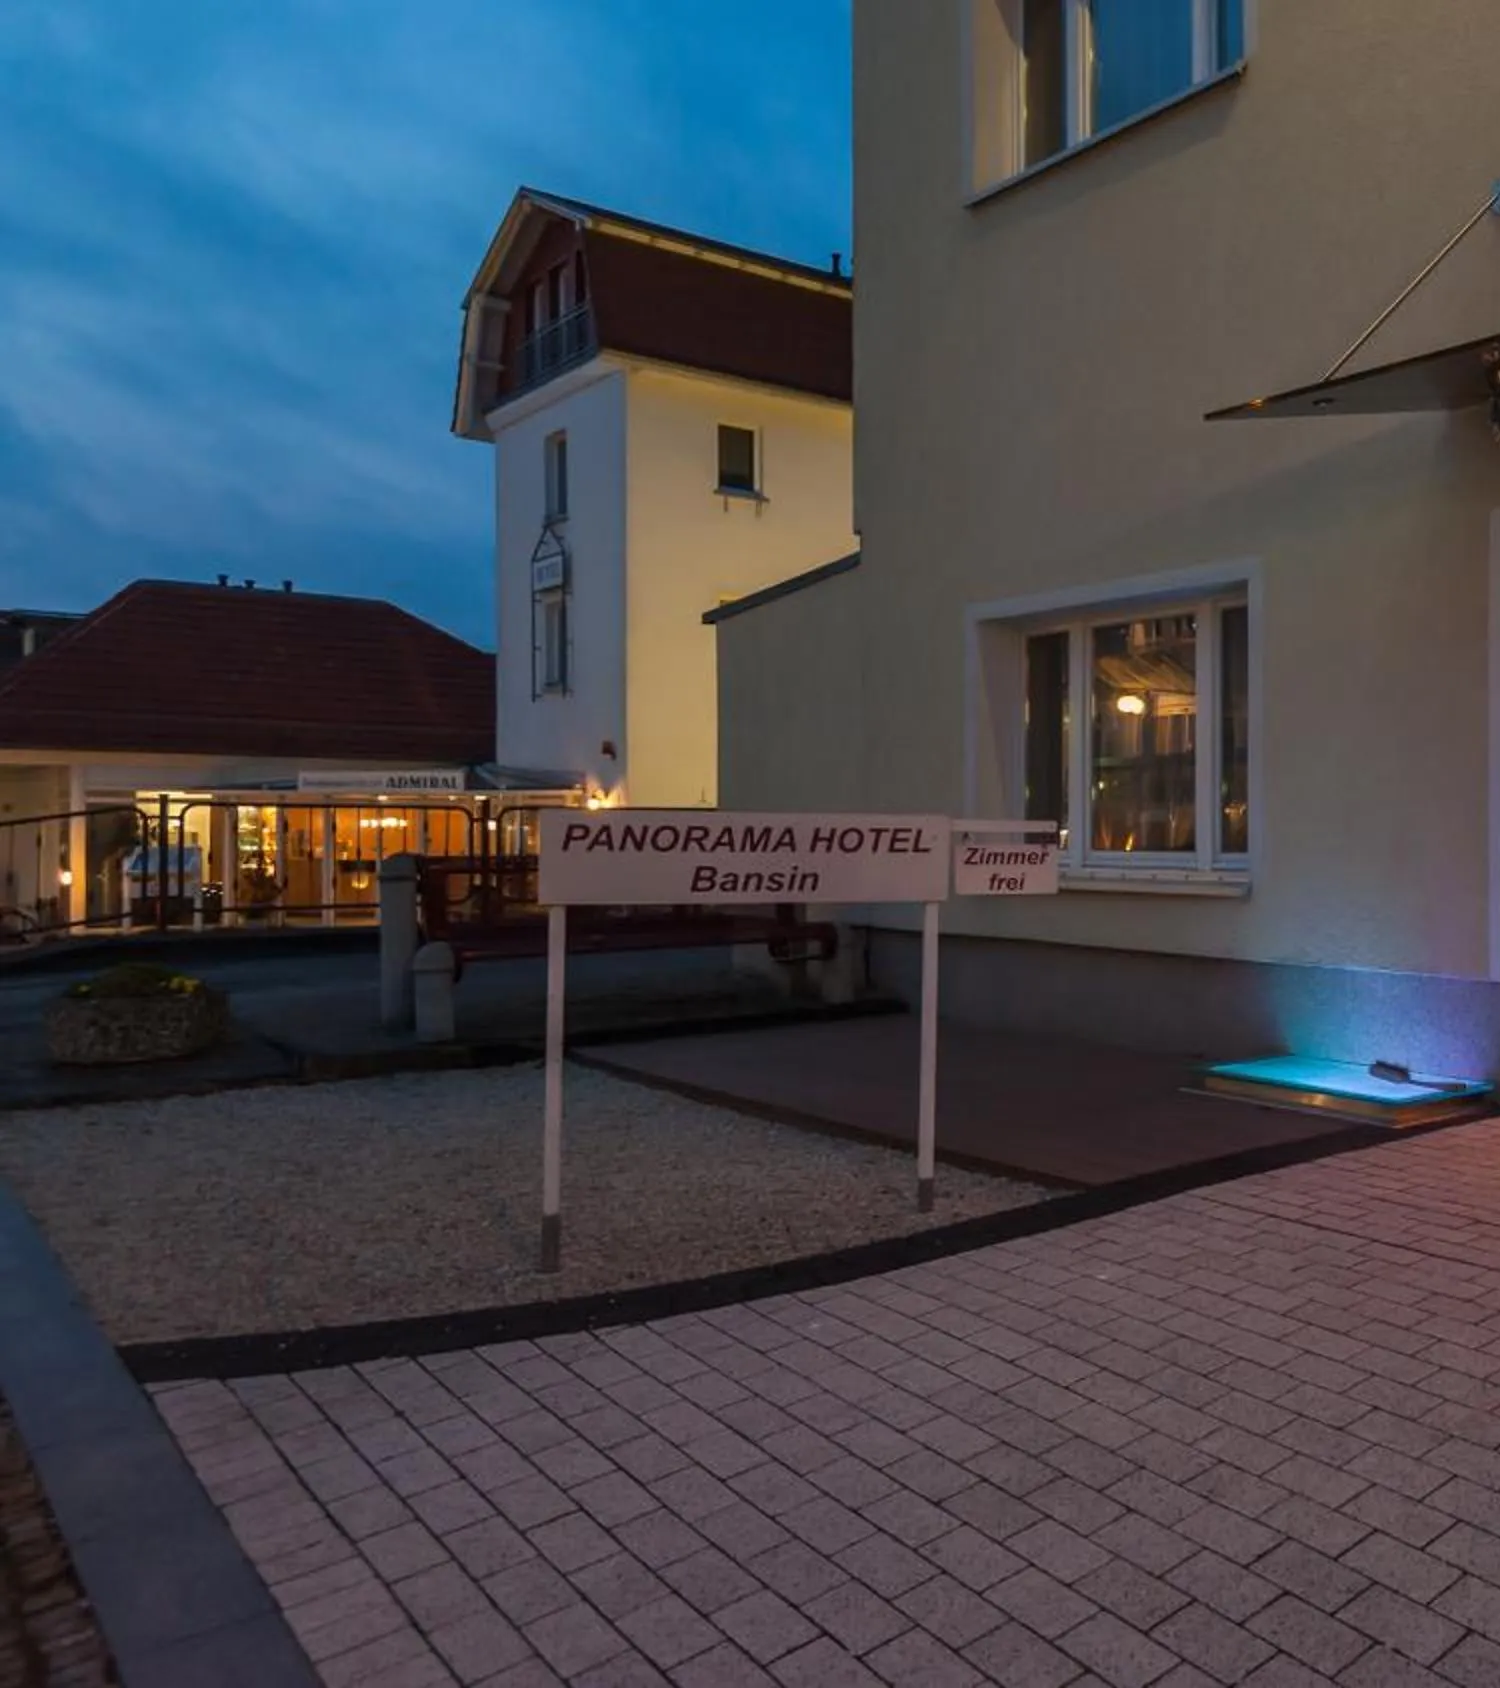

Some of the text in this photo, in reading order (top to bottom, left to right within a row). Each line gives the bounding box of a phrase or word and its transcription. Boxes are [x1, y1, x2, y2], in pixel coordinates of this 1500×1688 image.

[386, 775, 457, 789] ADMIRAL
[562, 824, 932, 853] PANORAMA HOTEL
[964, 848, 1050, 866] Zimmer
[690, 865, 820, 892] Bansin
[988, 873, 1026, 891] frei
